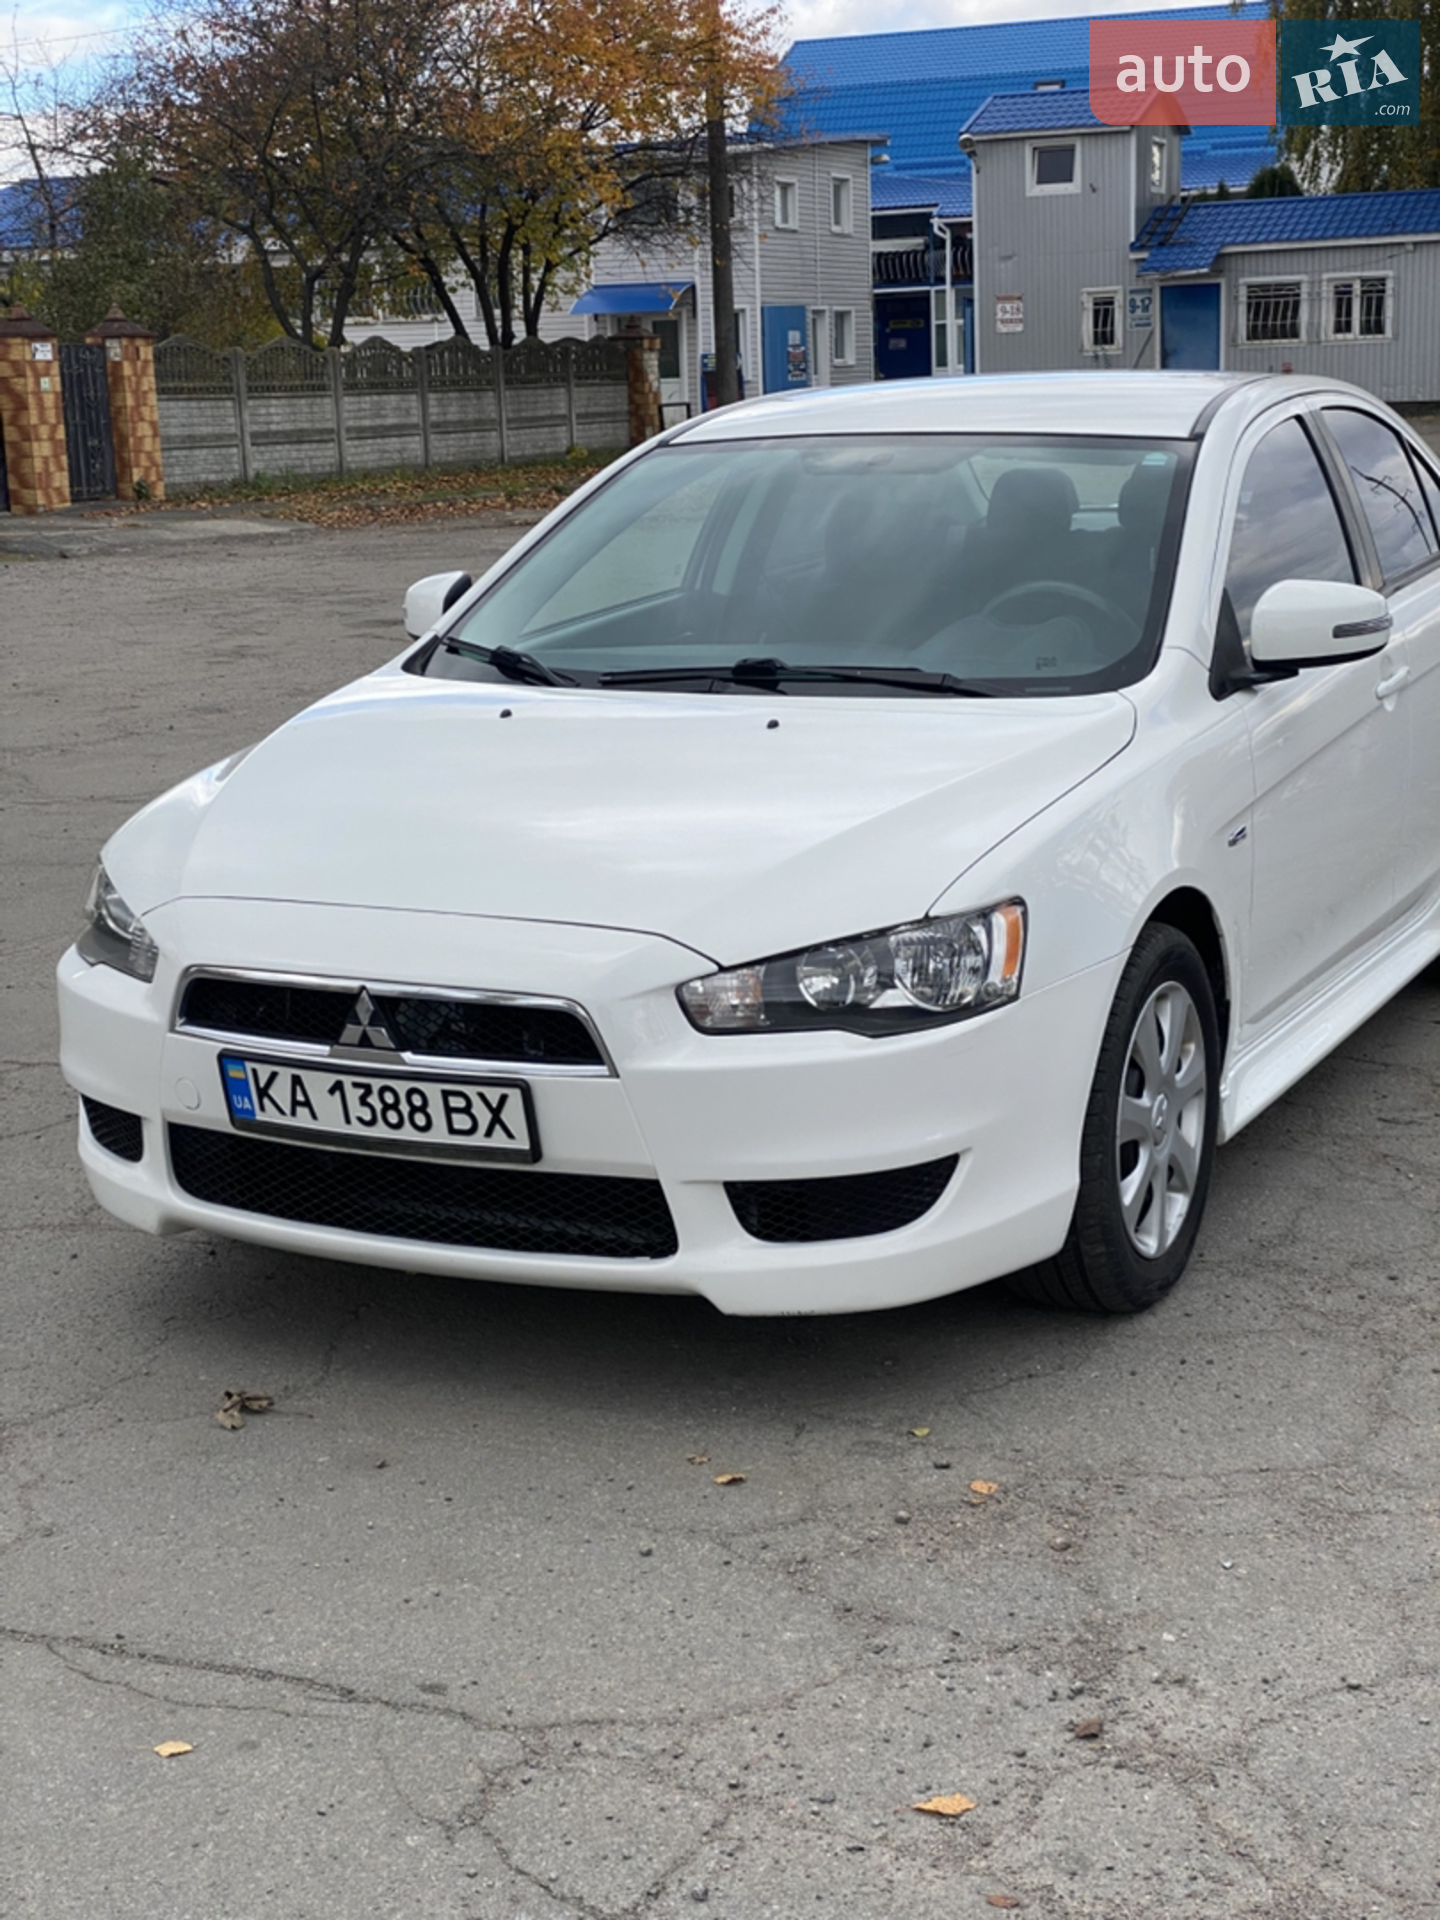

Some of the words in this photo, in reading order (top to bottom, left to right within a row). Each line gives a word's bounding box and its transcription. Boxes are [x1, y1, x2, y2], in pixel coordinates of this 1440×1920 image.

[233, 1094, 253, 1111] UA
[250, 1067, 318, 1121] KA
[327, 1079, 433, 1133] 1388
[440, 1088, 516, 1140] BX
